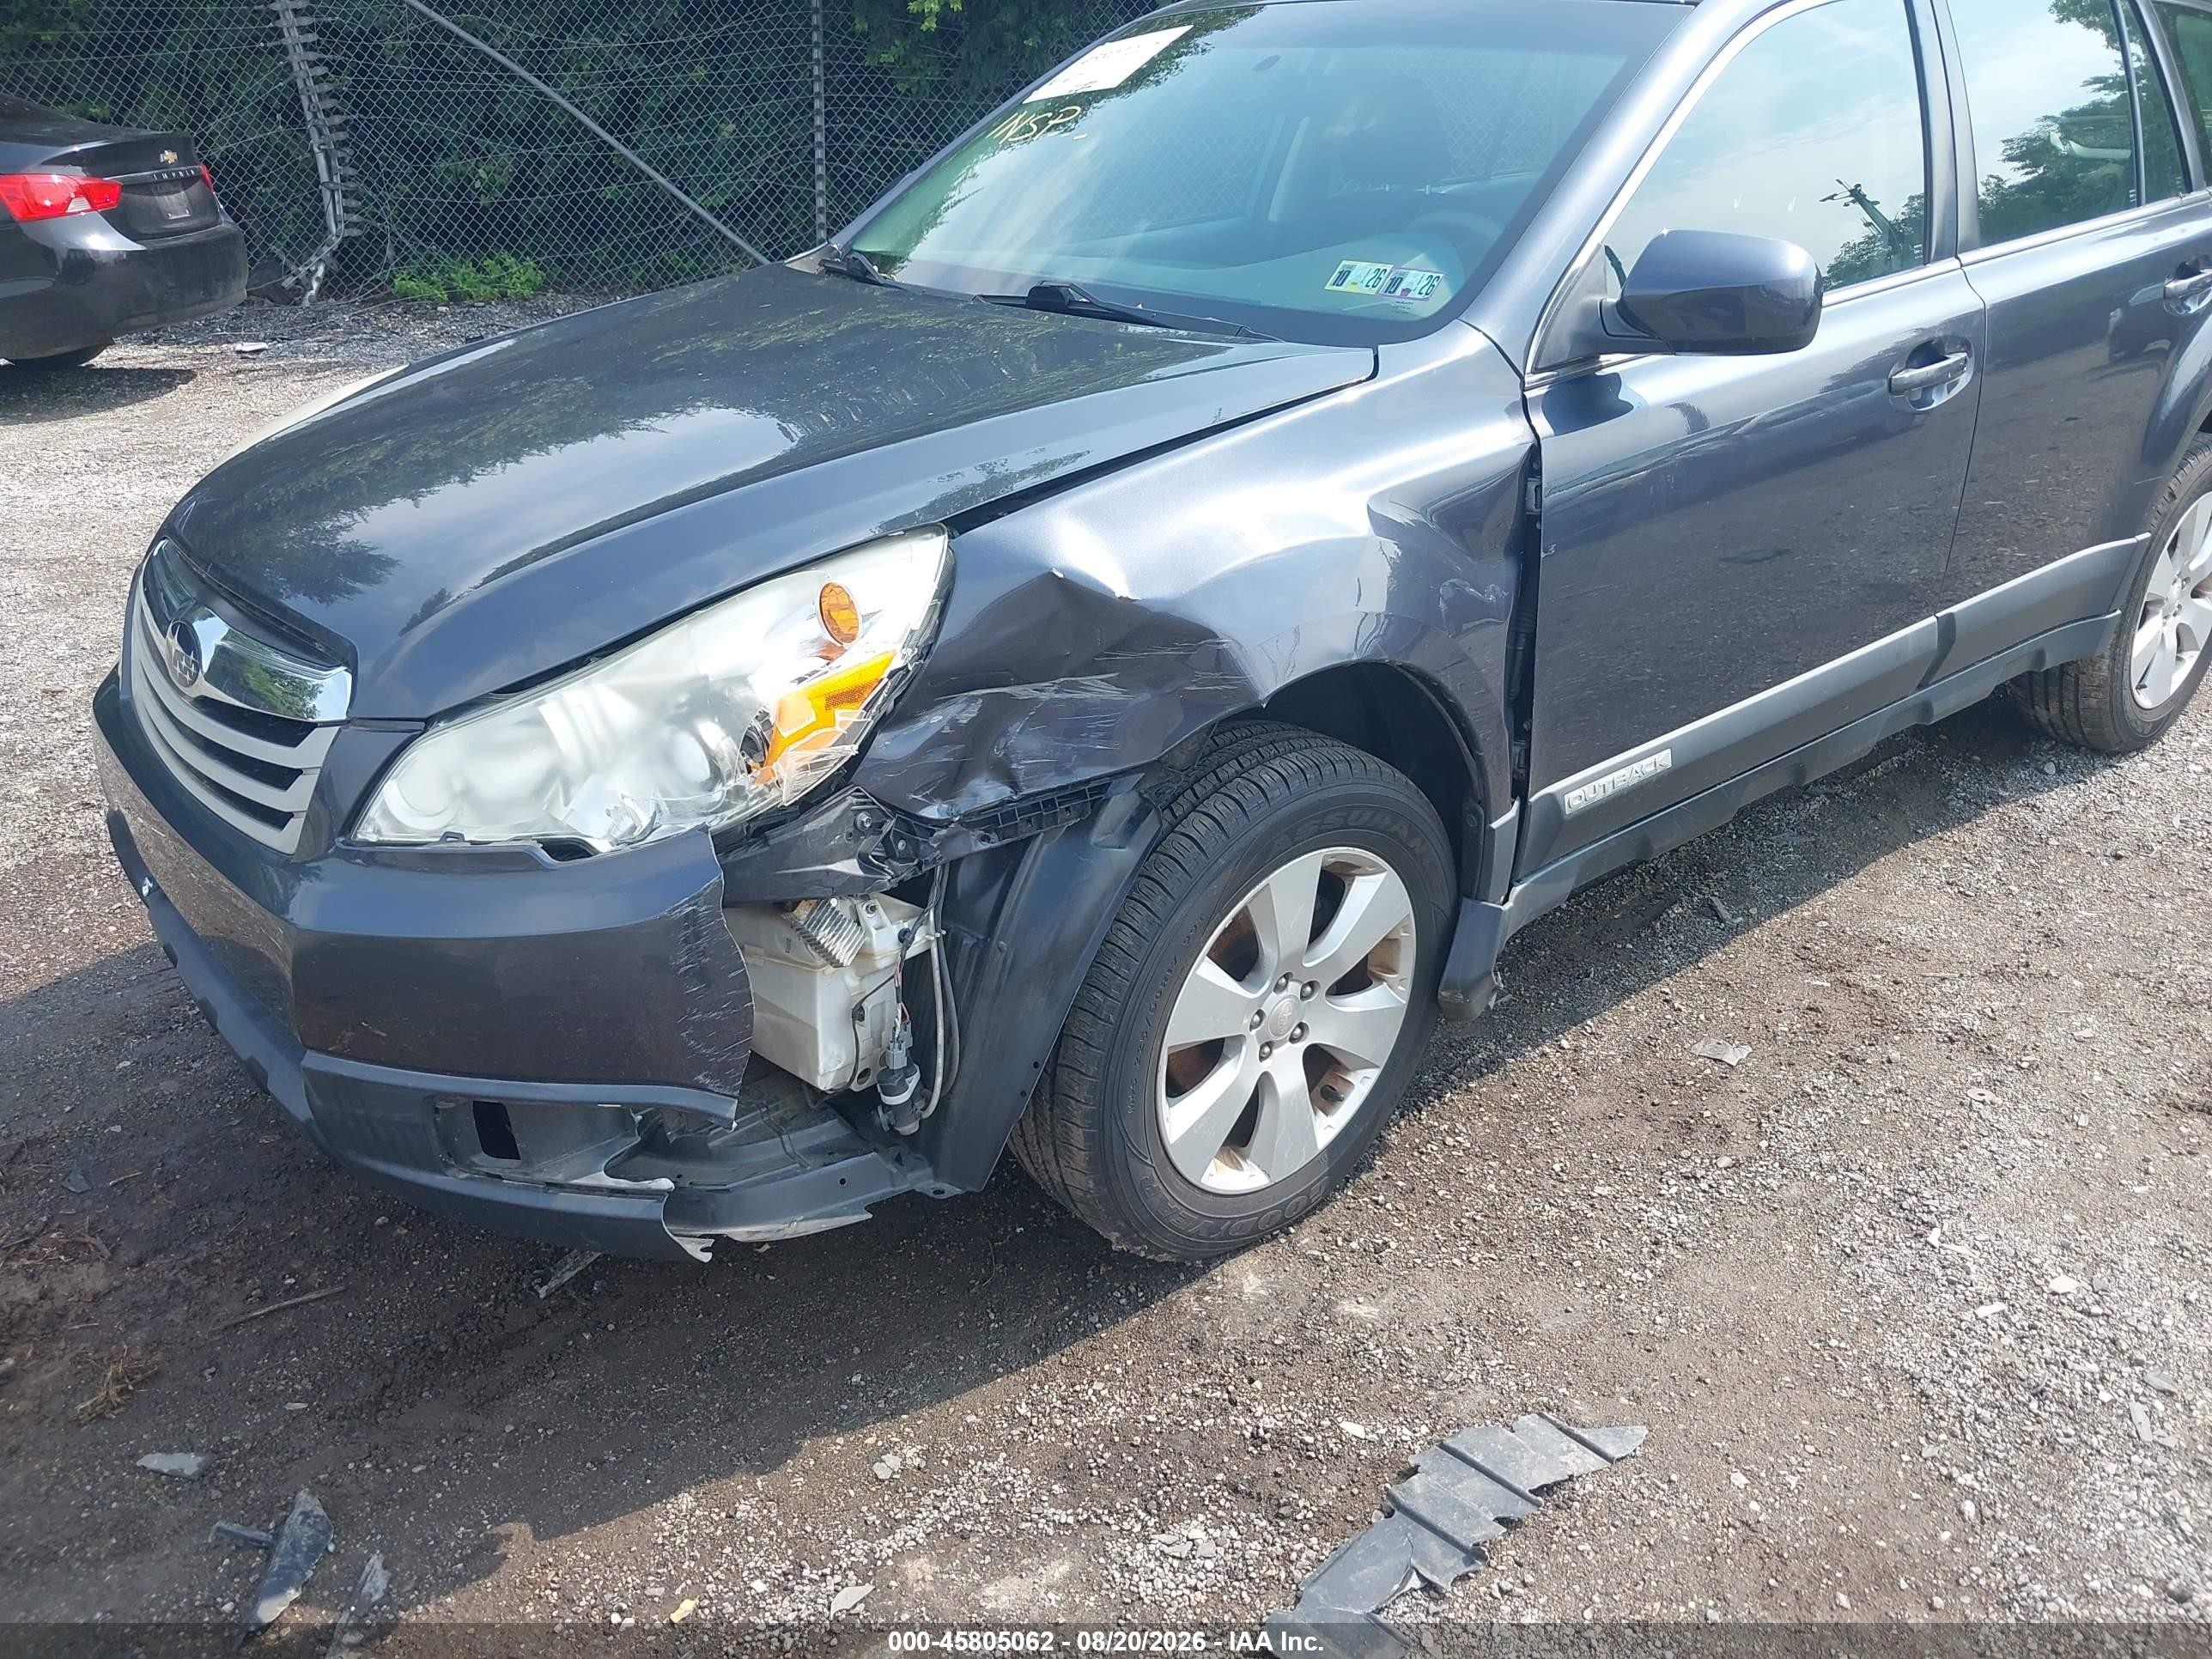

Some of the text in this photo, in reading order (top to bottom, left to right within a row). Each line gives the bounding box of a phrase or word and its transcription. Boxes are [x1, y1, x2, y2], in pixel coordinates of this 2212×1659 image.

[1333, 268, 1388, 289] 10 26
[1384, 275, 1440, 296] 10 26
[1567, 757, 1669, 809] OUTBACK
[1139, 1174, 1331, 1238] GOODYEAR
